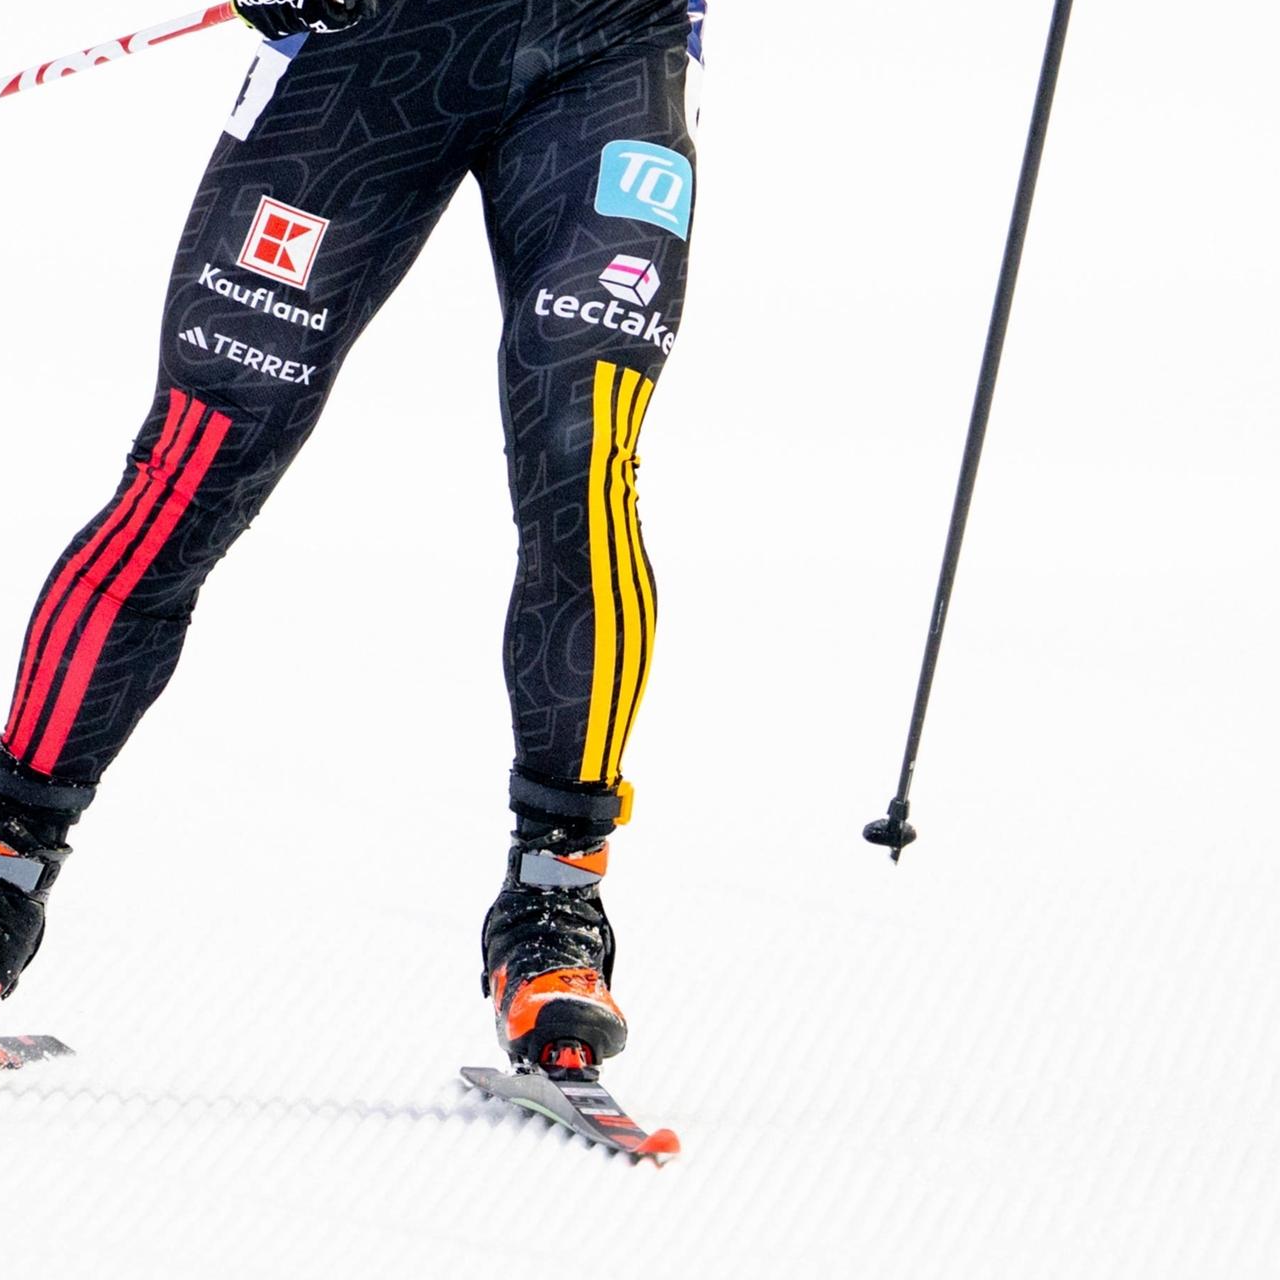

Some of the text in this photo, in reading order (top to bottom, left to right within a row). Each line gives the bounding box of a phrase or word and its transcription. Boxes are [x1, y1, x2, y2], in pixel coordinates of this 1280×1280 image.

[197, 263, 328, 331] Kaufland
[534, 288, 676, 356] tectake
[213, 333, 317, 385] TERREX
